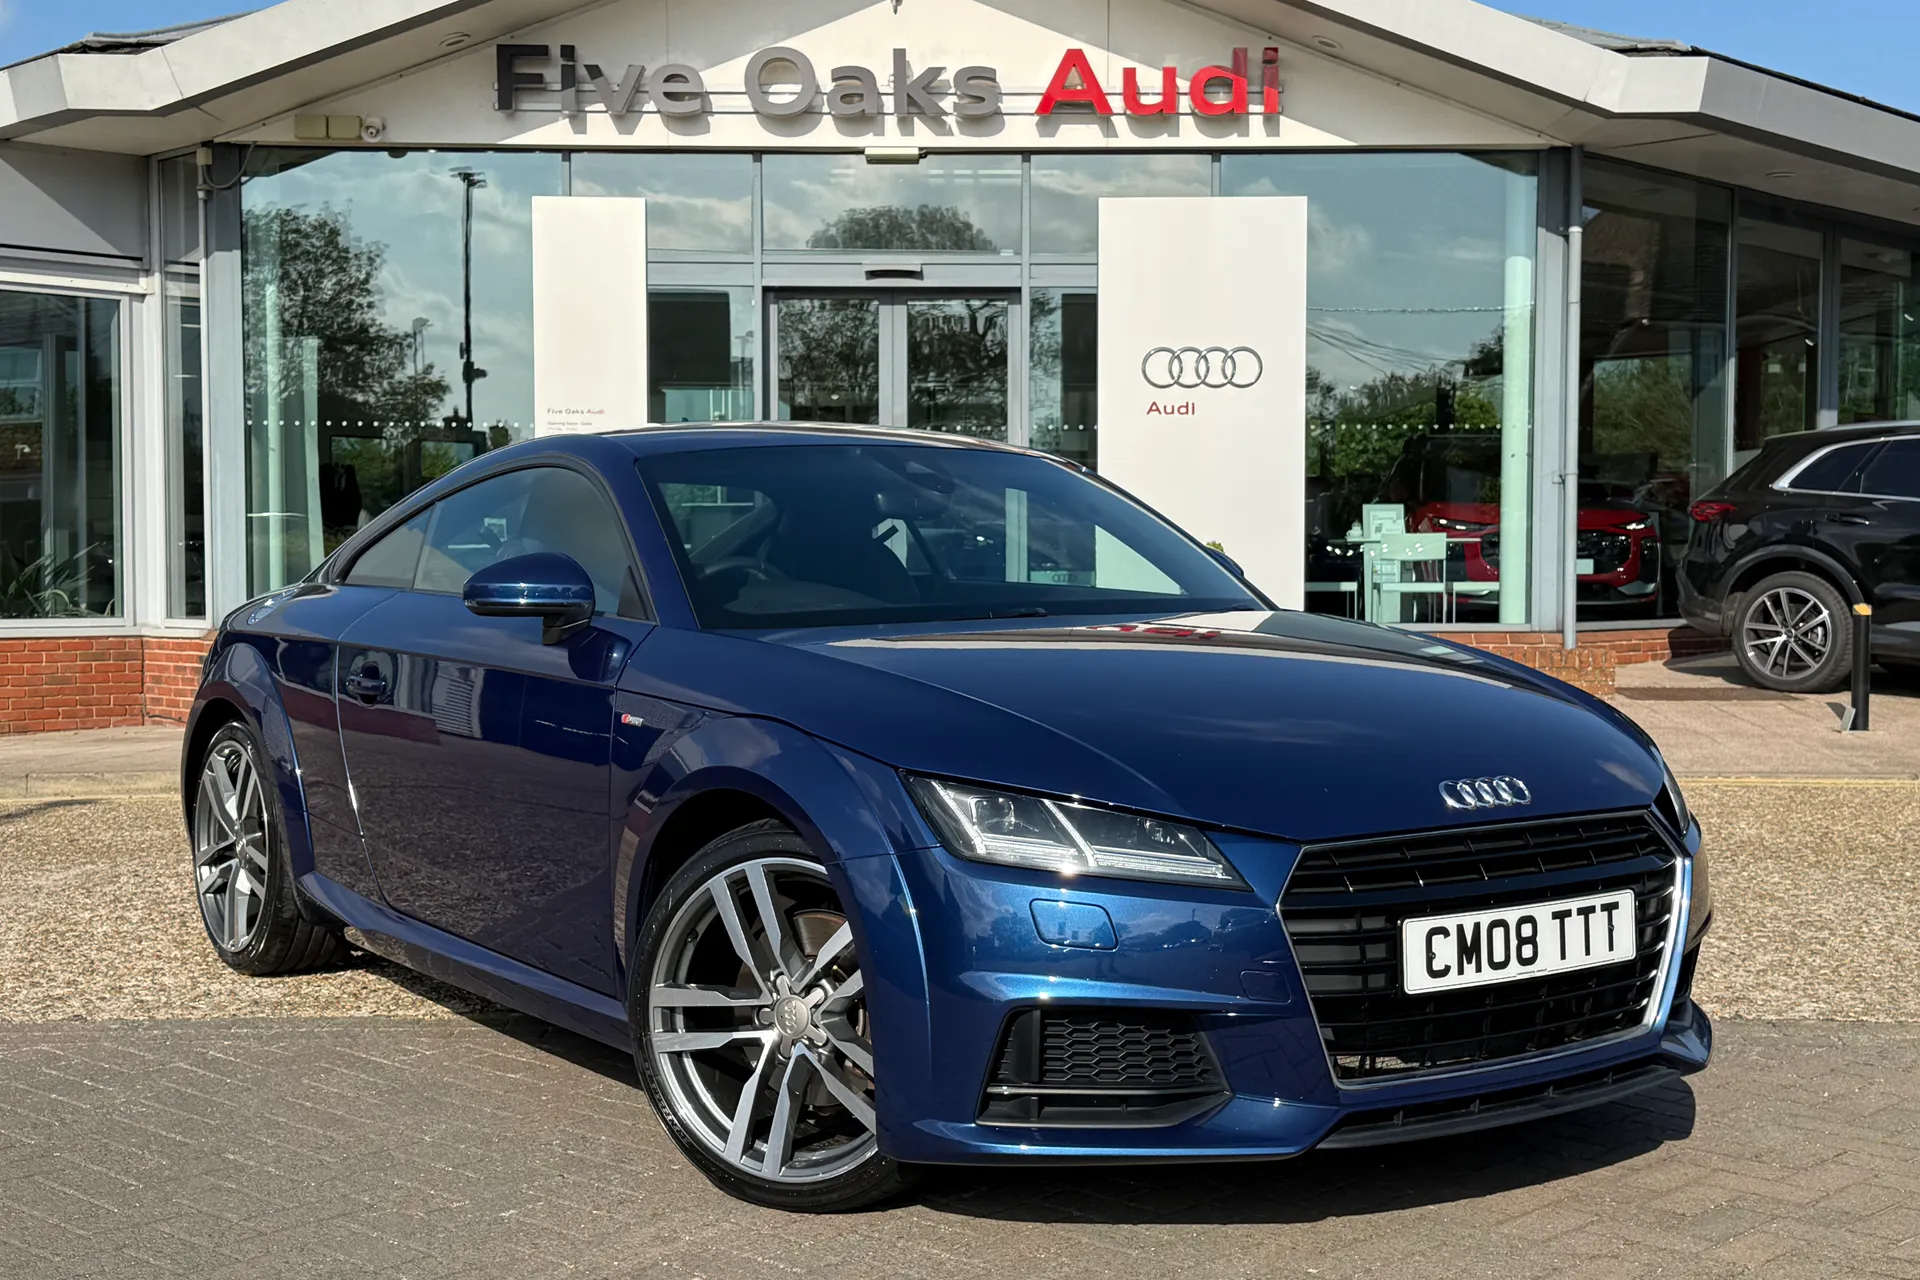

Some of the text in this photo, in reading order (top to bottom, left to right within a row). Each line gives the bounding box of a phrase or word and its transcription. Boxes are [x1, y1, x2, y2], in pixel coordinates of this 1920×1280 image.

[496, 44, 1279, 117] Five Oaks Audi
[1146, 401, 1195, 415] Audi
[1425, 901, 1619, 979] CM08 TTT
